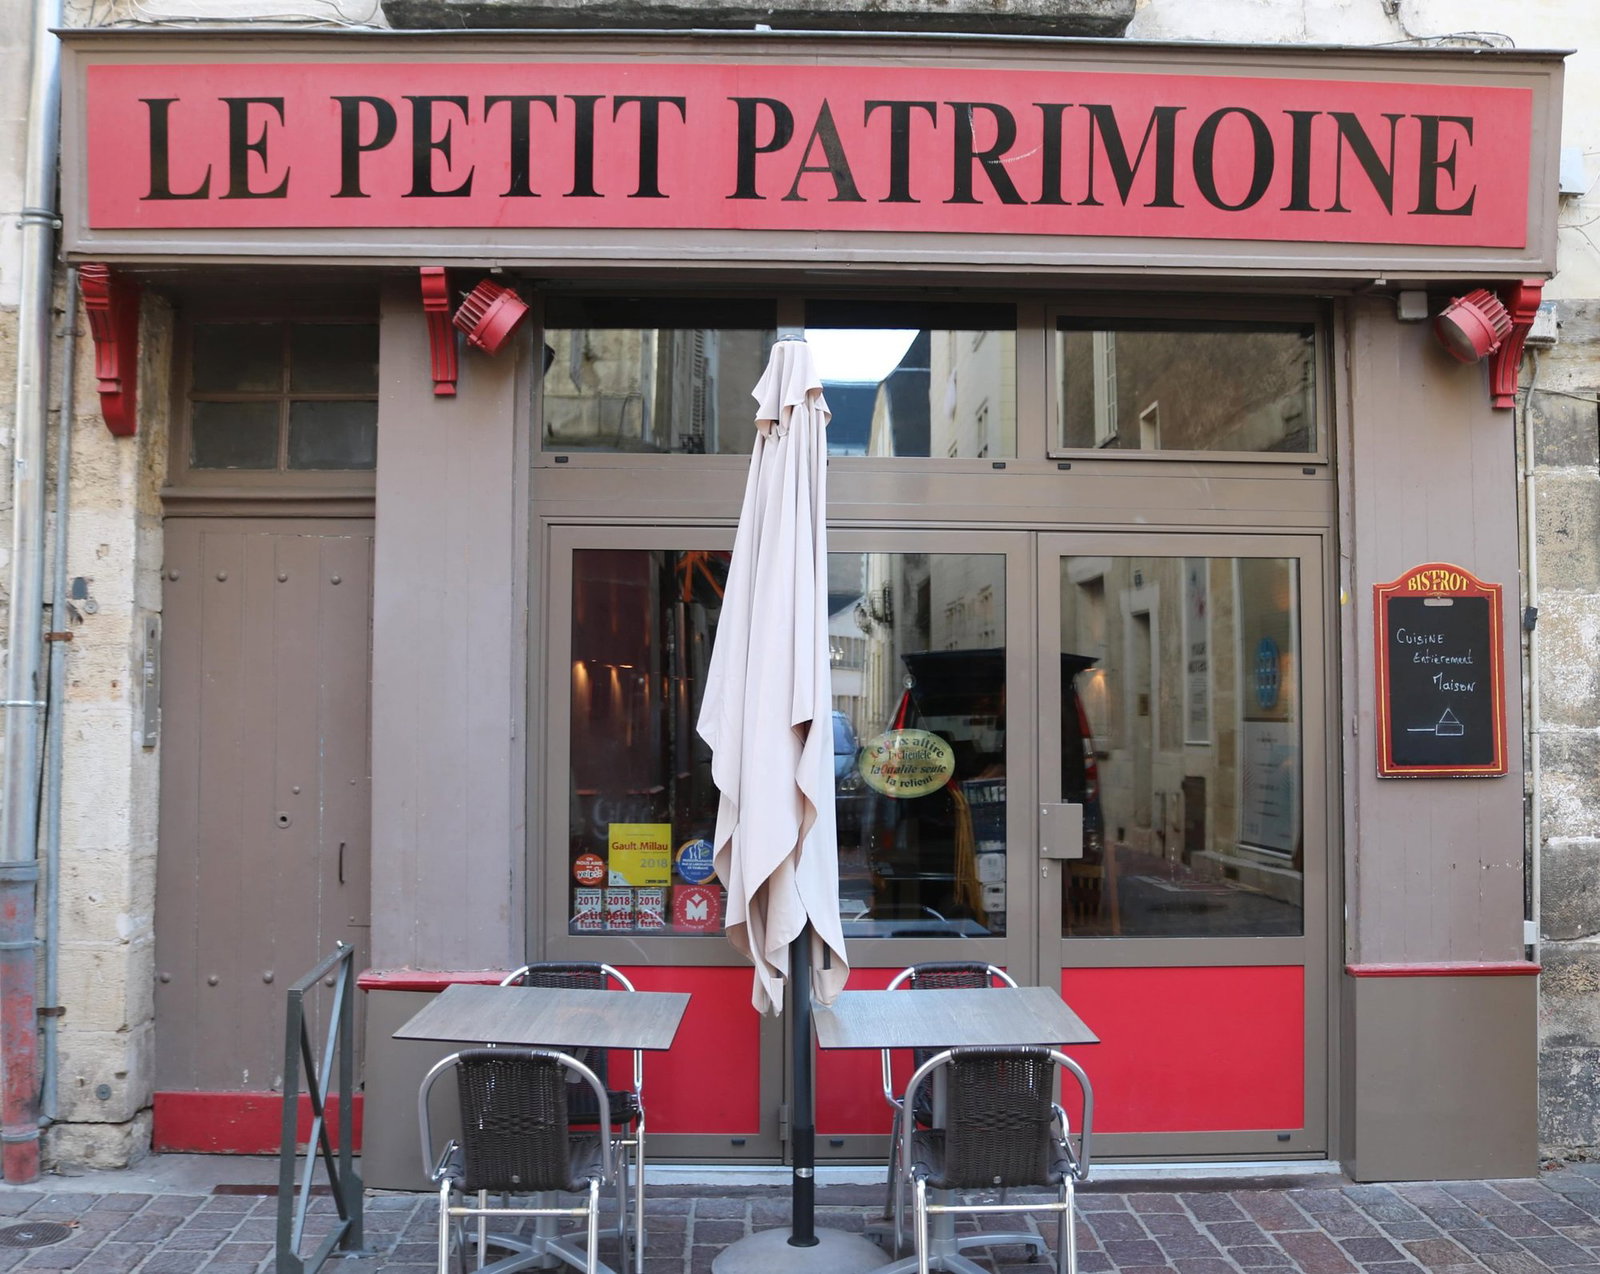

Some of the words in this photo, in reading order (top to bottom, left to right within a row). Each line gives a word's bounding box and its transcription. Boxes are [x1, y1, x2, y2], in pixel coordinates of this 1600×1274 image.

[138, 97, 290, 201] LE
[330, 95, 687, 199] PETIT
[726, 97, 1477, 216] PATRIMOINE
[1407, 569, 1470, 591] BISTROT
[640, 858, 669, 868] 2018
[578, 896, 600, 905] 2017
[608, 896, 630, 905] 2018
[639, 896, 661, 905] 2016
